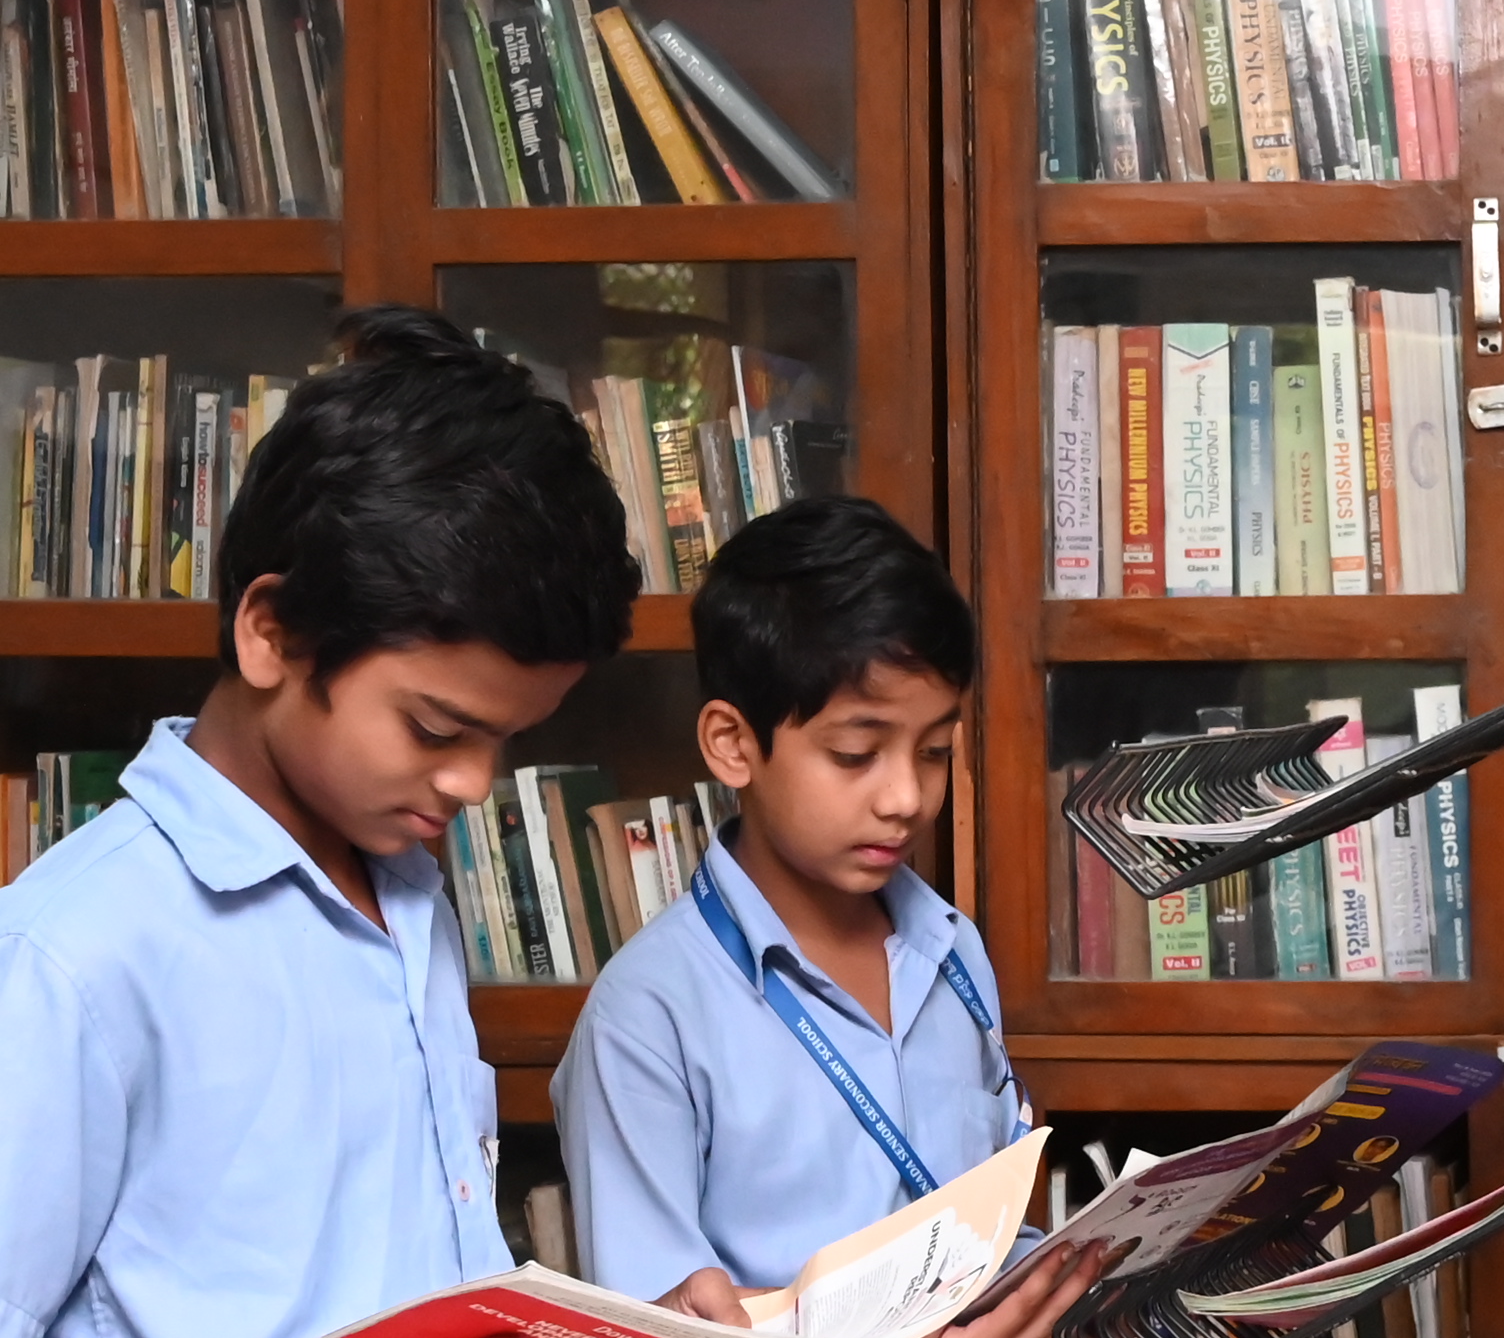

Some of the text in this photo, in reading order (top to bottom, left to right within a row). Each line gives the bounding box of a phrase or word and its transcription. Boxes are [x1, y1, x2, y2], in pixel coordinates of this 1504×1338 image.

[501, 22, 520, 74] Wallace
[516, 25, 532, 65] Irving
[659, 31, 687, 59] After
[1127, 44, 1138, 56] of
[1201, 26, 1228, 106] PHYSICS
[1355, 32, 1372, 85] PHYSICS
[1409, 11, 1428, 78] PHYSICS
[486, 61, 516, 171] Essay Book
[510, 78, 532, 111] Seven
[530, 87, 544, 109] The
[6, 104, 20, 158] HAMLET
[656, 431, 680, 481] SMITH
[1127, 367, 1149, 536] NEW MILLENNIUM PHYSICS
[1184, 421, 1204, 519] PHYSICS
[1206, 420, 1220, 518] FUNDAMENTAL
[1331, 352, 1354, 520] FUNDAMENTALS OF PHYSICS
[1380, 422, 1394, 489] PHYSICS
[1057, 431, 1077, 528] PHYSICS
[1079, 430, 1093, 528] FUNDAMENTAL
[1300, 451, 1314, 524] PHYSICS
[1362, 416, 1382, 531] PHYSICS VOLUME
[1250, 511, 1264, 557] PHYSICS
[1438, 782, 1460, 868] PHYSICS
[1342, 889, 1362, 957] PHYSICS
[1356, 894, 1370, 949] OBJECTIVE
[1408, 845, 1423, 936] FUNDAMENTAL
[797, 1016, 909, 1157] SCHOOL SECONDARY SENIOR
